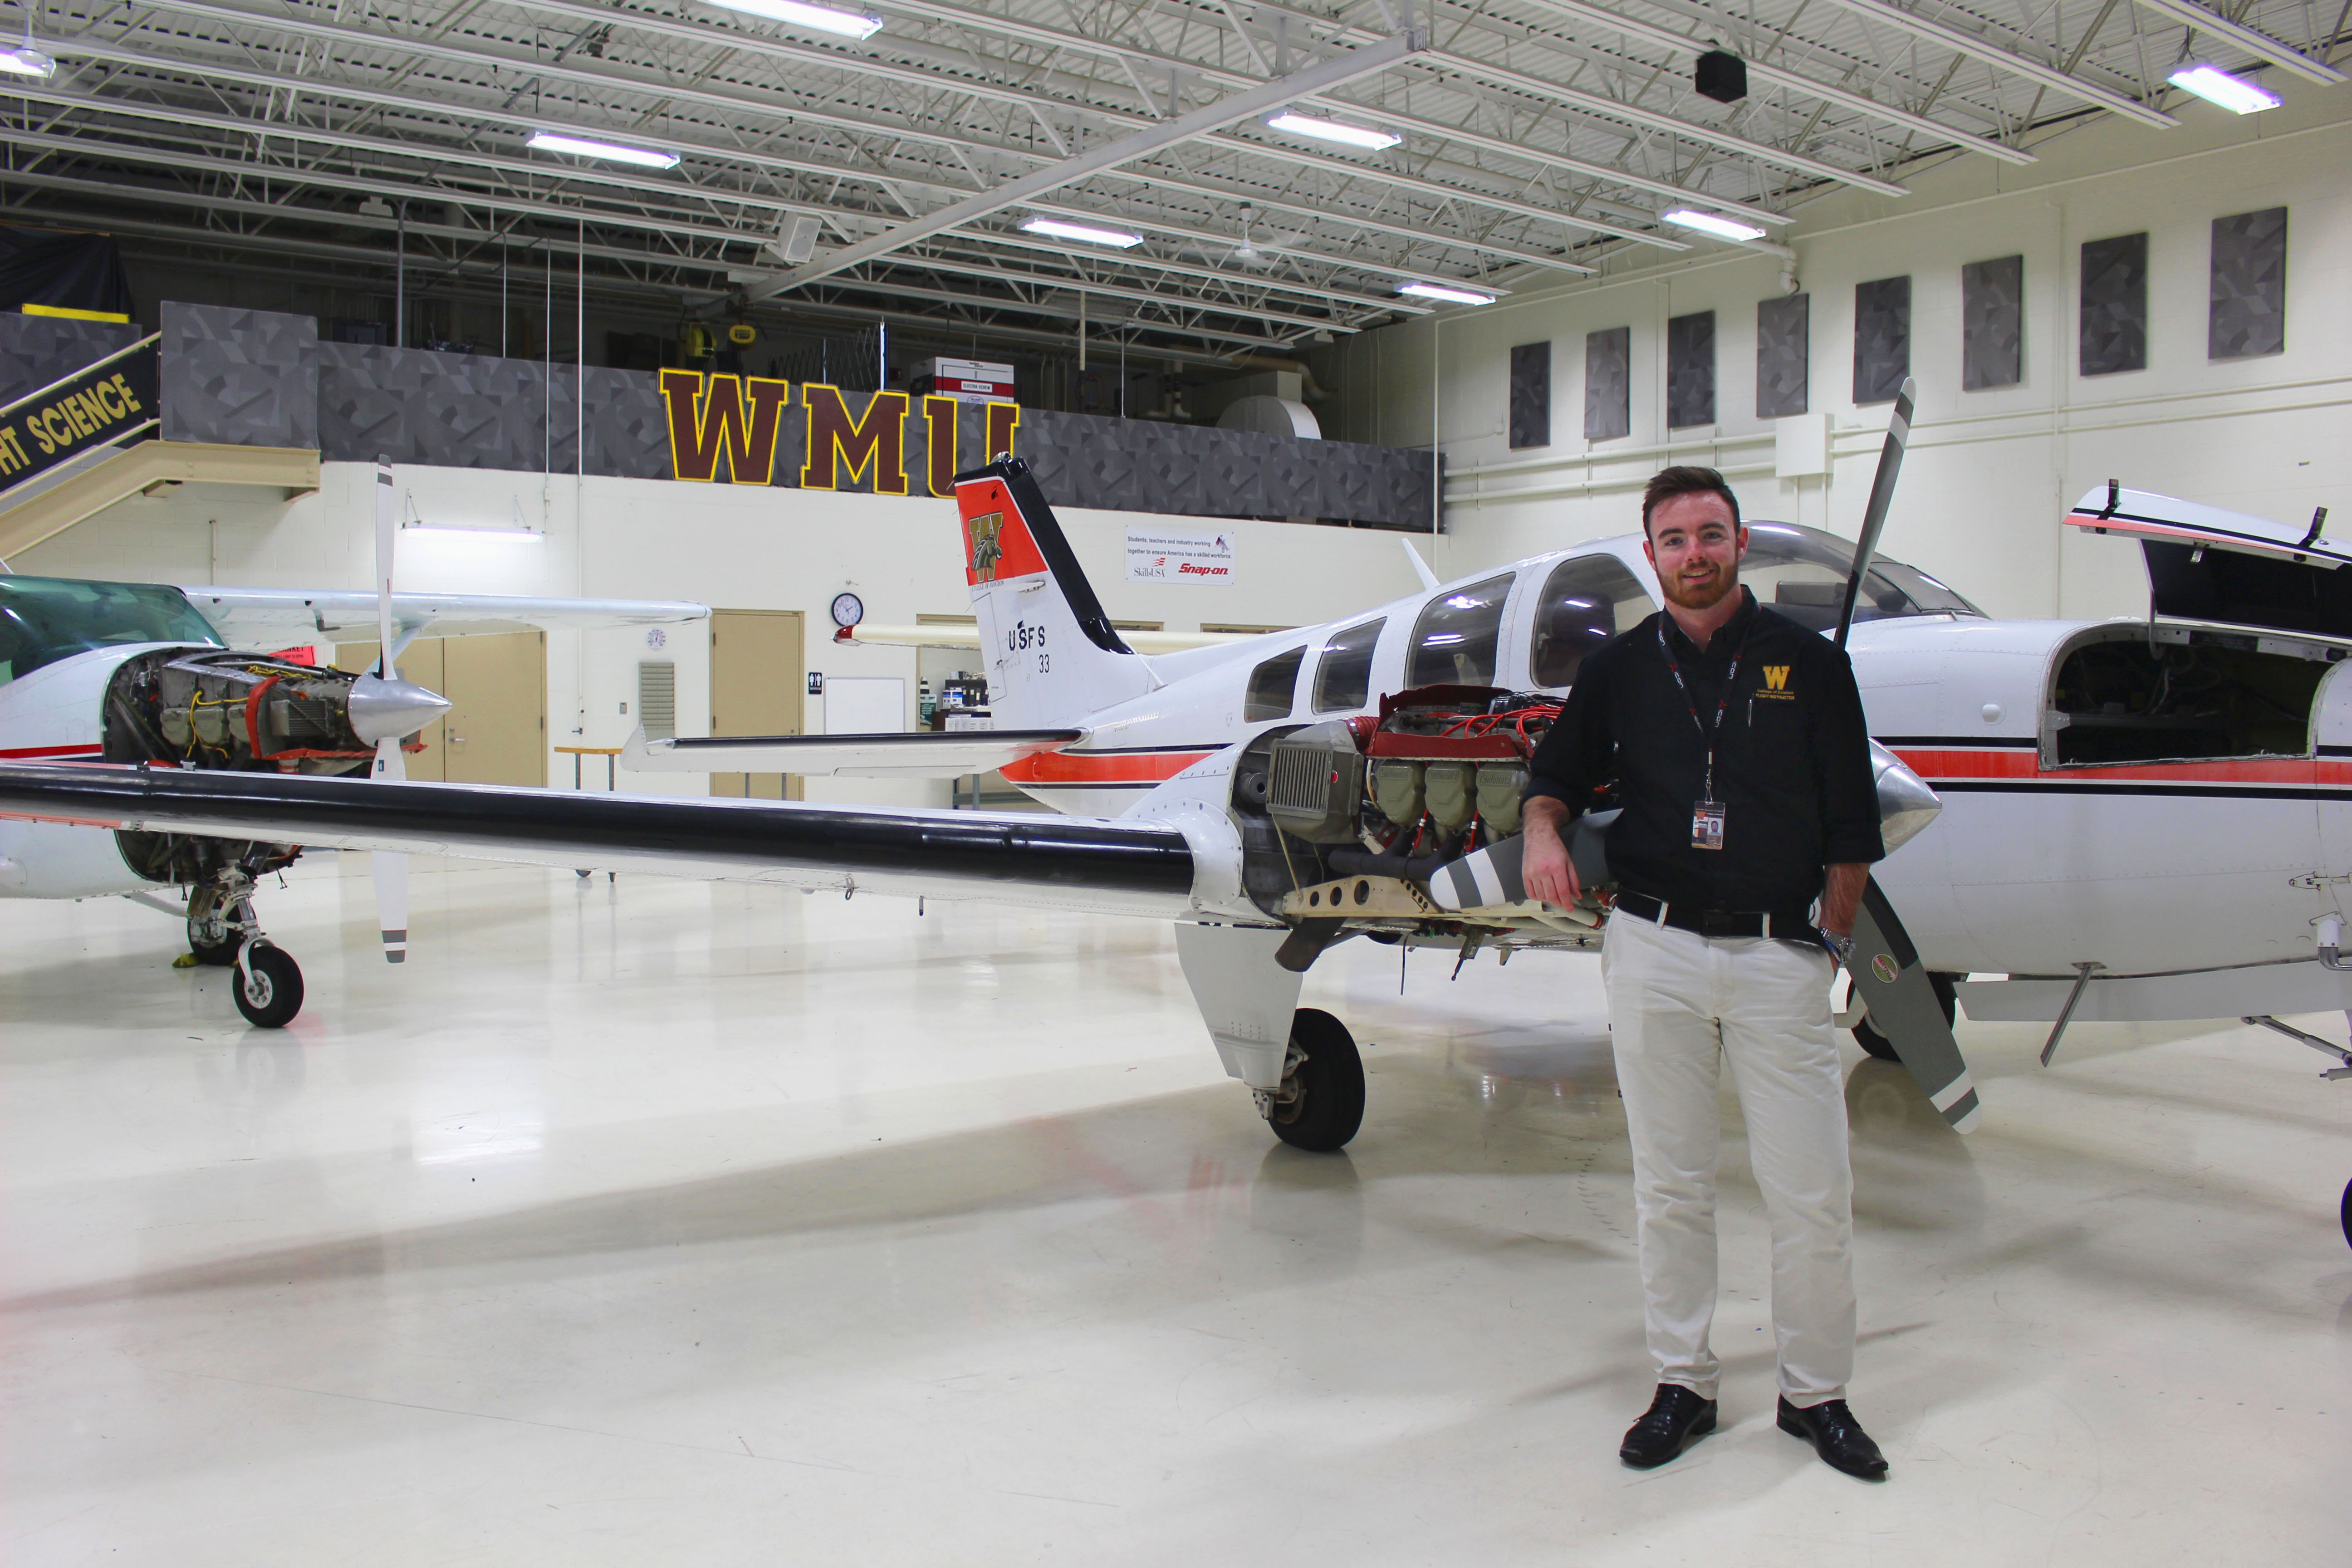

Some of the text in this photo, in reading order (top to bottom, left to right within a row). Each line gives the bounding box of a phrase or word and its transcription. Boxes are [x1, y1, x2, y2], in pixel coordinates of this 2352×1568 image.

[26, 373, 142, 454] SCIENCE
[659, 368, 1019, 499] WMU
[1134, 567, 1165, 578] SkillsUSA
[1178, 563, 1228, 576] Snap-on
[1009, 626, 1045, 651] USFS
[1039, 654, 1049, 673] 33
[1763, 666, 1790, 690] W
